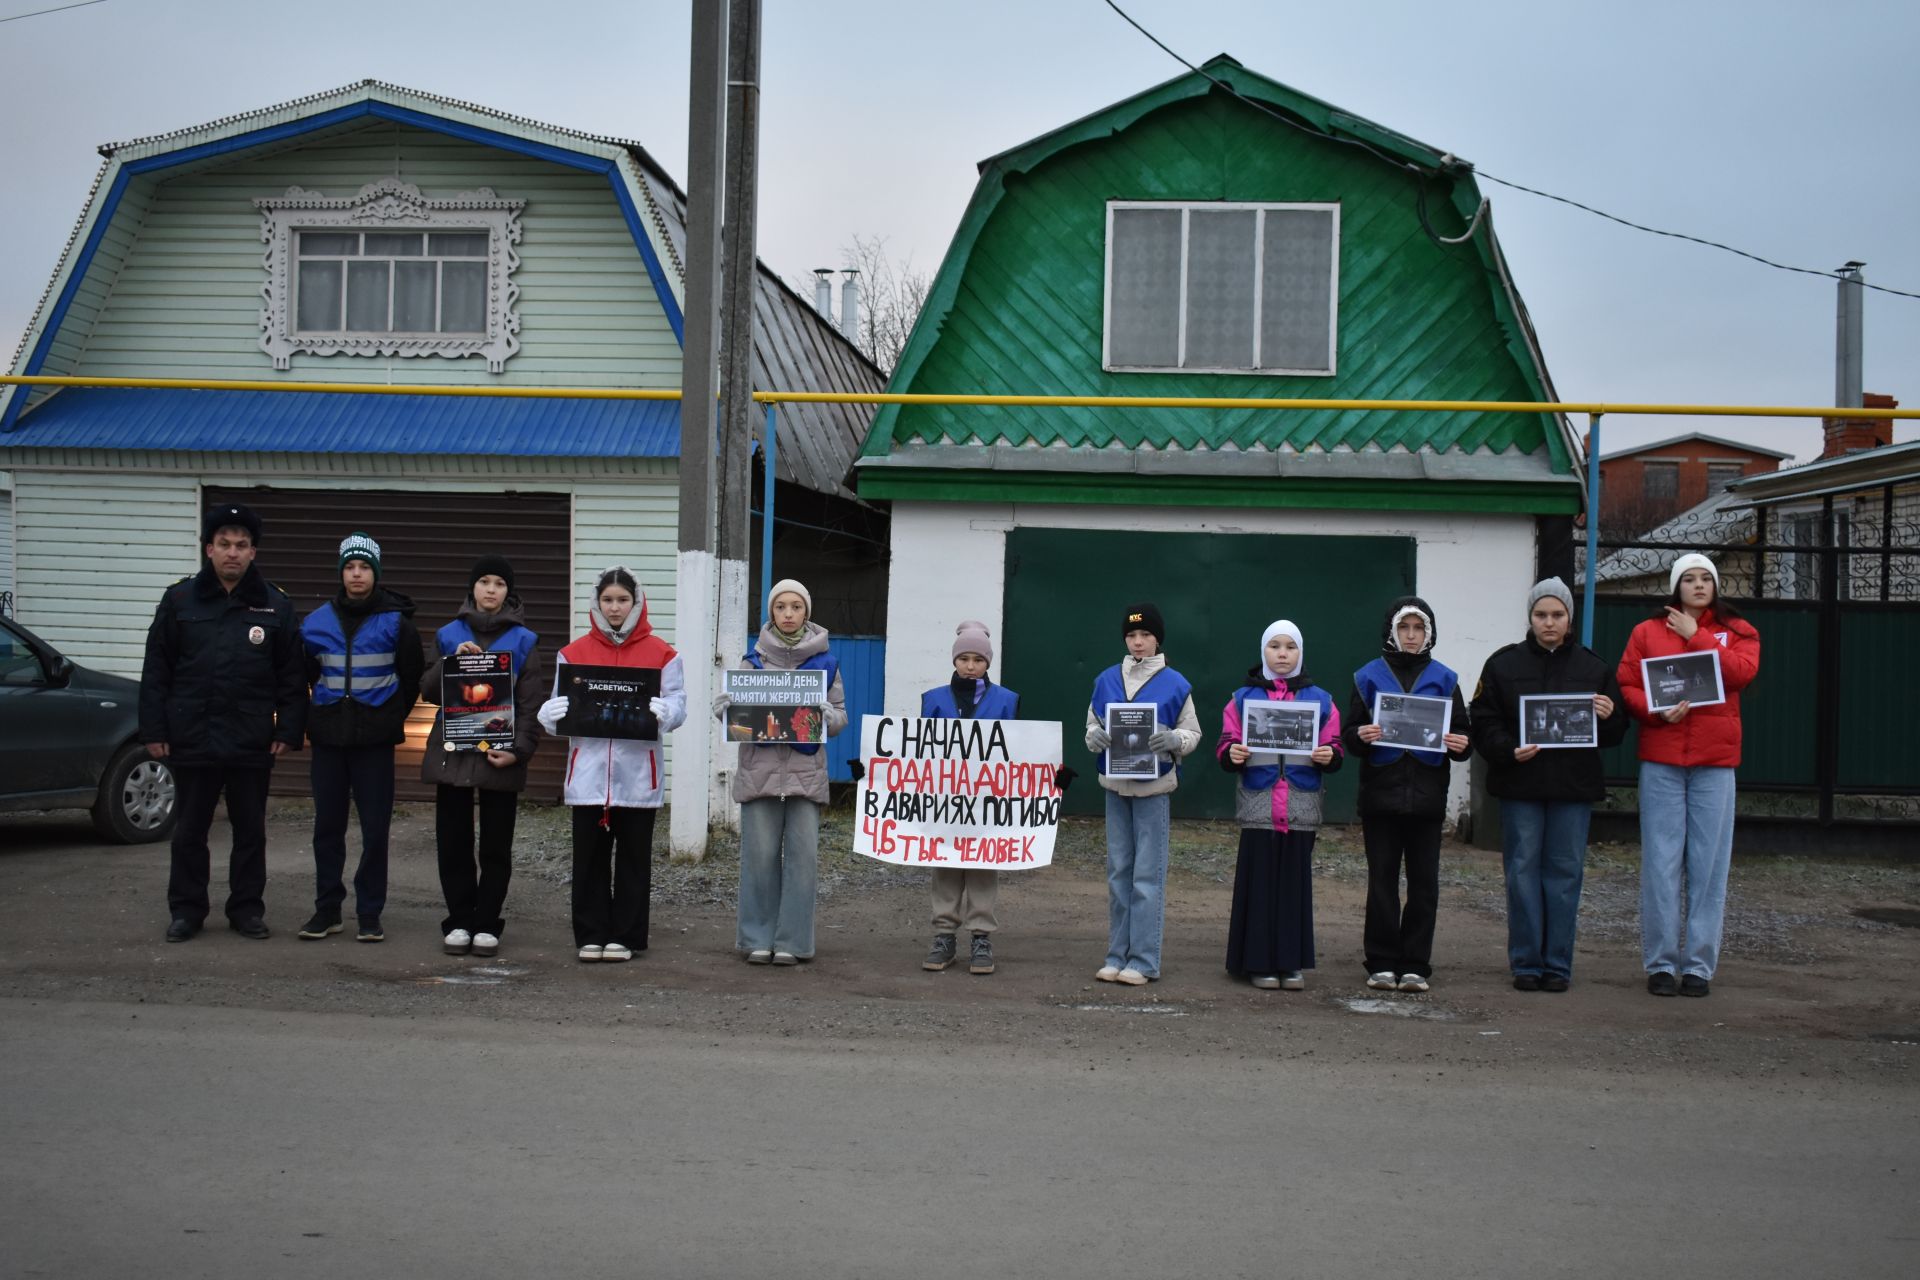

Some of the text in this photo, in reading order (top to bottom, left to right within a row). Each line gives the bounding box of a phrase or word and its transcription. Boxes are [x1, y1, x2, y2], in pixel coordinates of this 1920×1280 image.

[1129, 613, 1142, 621] NYC
[589, 684, 633, 692] ЗАСВЕТИСЬ
[732, 672, 819, 689] ВСЕМИРНЫЙ ДЕНЬ
[769, 692, 801, 703] ЖЕРТВ
[803, 692, 822, 705] ДТП
[875, 717, 1010, 762] С НАЧАЛА
[868, 757, 1064, 797] ГОДА НА ДОРОГАХ
[865, 789, 1061, 828] В АВАРИЯХ ПОГИБЛО
[863, 815, 1036, 864] 4,6 ТЫС. ЧЕЛОВЕК
